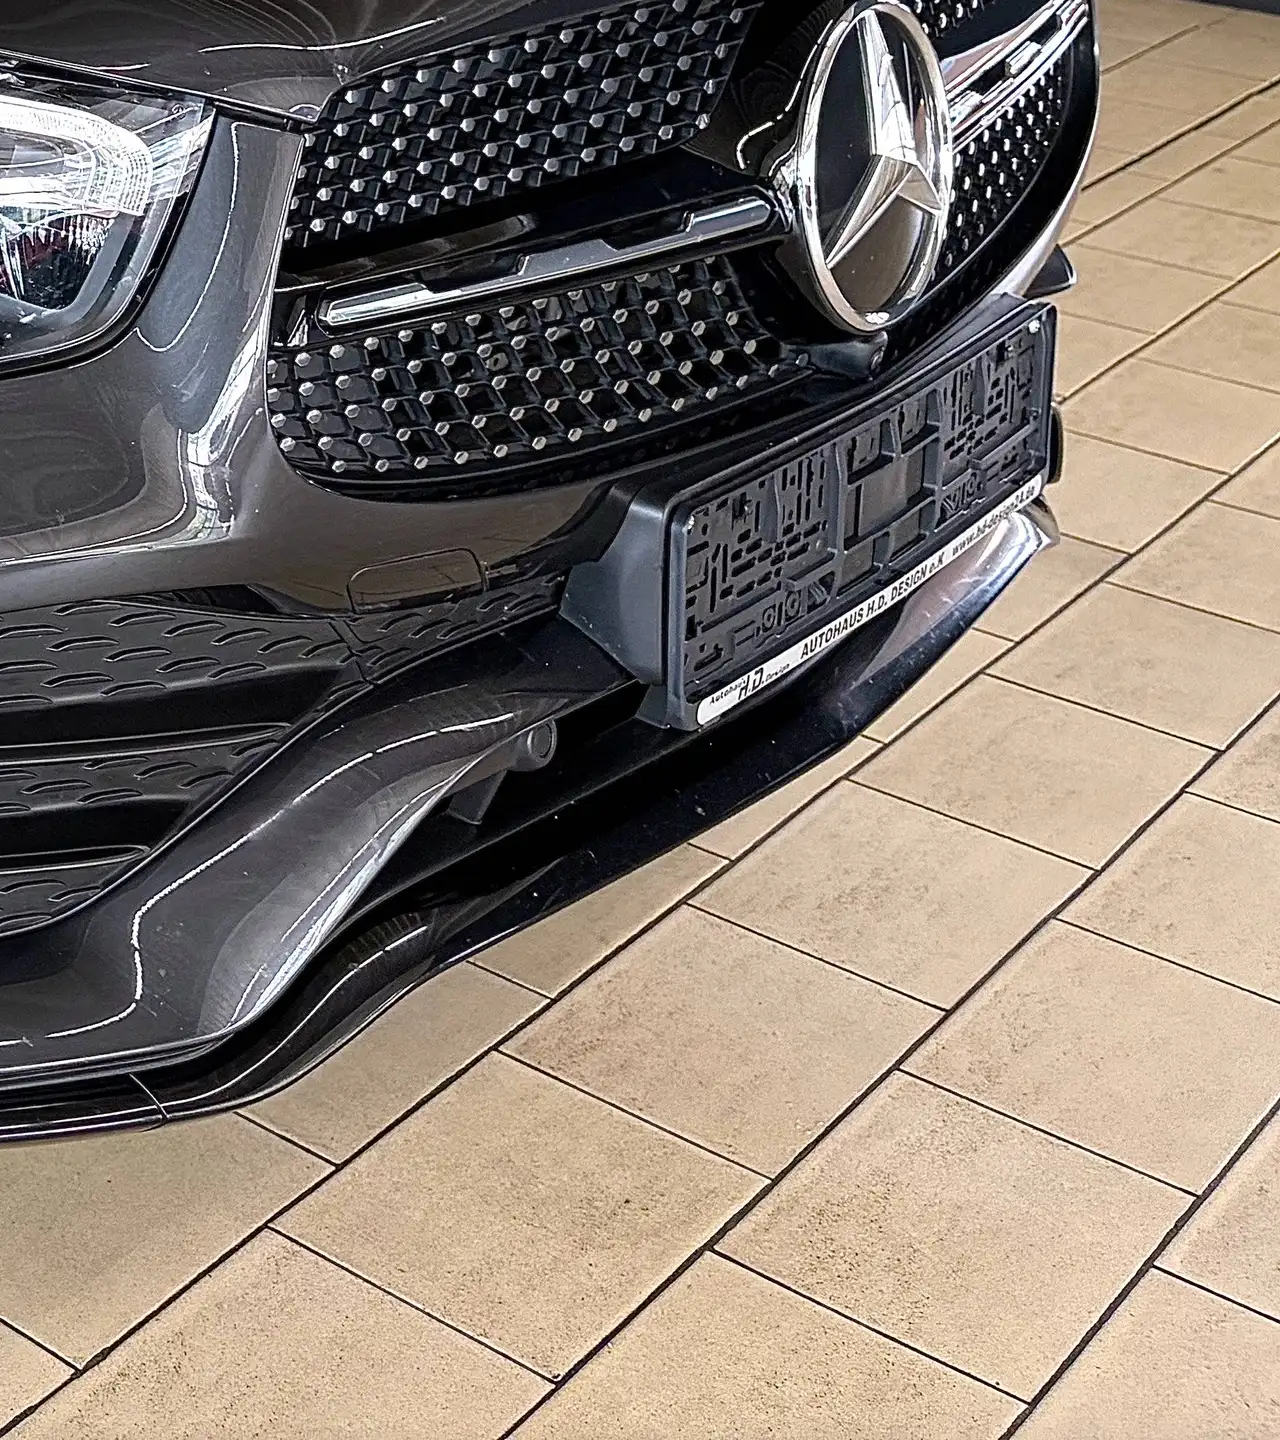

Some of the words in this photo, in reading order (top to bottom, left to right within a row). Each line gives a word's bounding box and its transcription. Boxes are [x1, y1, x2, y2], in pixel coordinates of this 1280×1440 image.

[800, 608, 864, 660] AUTOHAUS
[866, 594, 888, 620] H.D.
[890, 565, 927, 601] DESIGN
